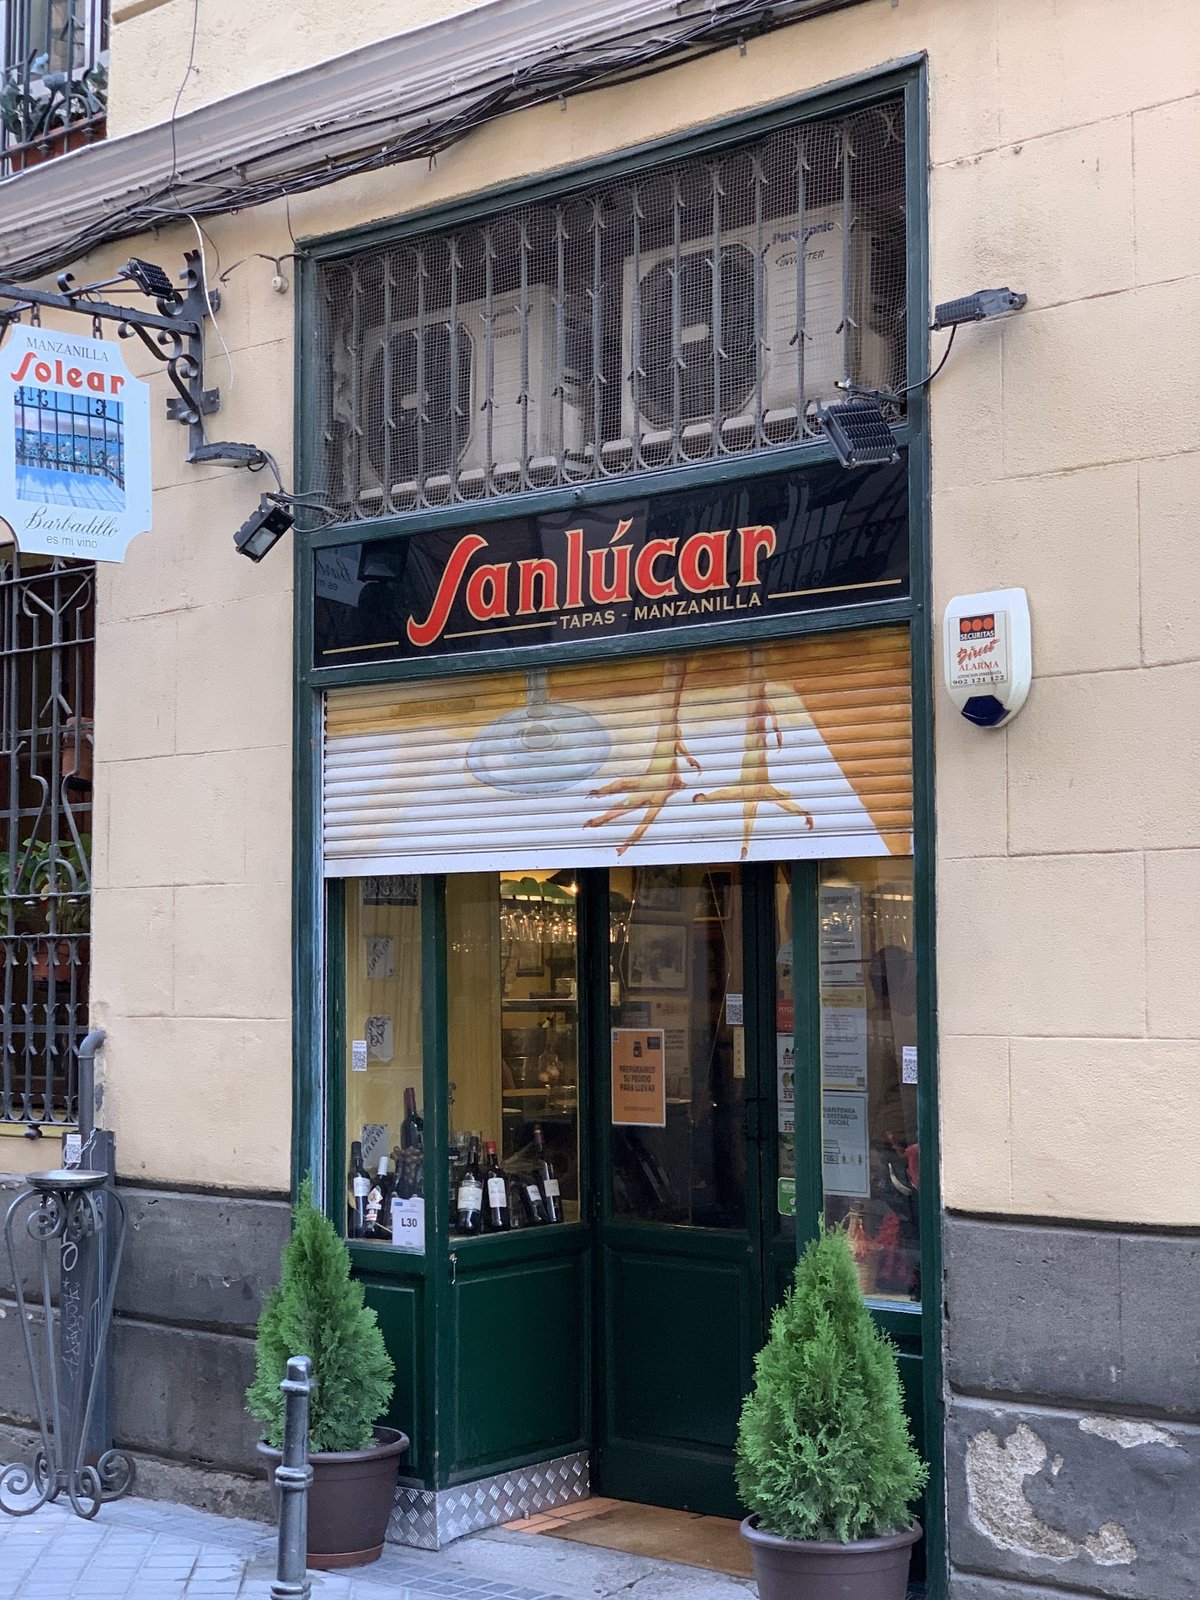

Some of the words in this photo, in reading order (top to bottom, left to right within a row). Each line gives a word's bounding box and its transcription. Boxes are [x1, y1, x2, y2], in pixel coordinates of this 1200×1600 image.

[26, 336, 109, 363] MANZANILLA
[10, 351, 125, 395] Solear
[23, 504, 120, 538] Barbadillo
[46, 535, 59, 546] es
[62, 537, 74, 546] mi
[77, 538, 98, 549] vino
[406, 516, 777, 647] Sanlúcar
[560, 608, 616, 630] TAPAS
[634, 592, 762, 621] MANZANILLA
[960, 630, 995, 641] SECURITAS
[956, 638, 1000, 665] Direct
[959, 663, 998, 672] ALARMA
[401, 1218, 418, 1228] L30
